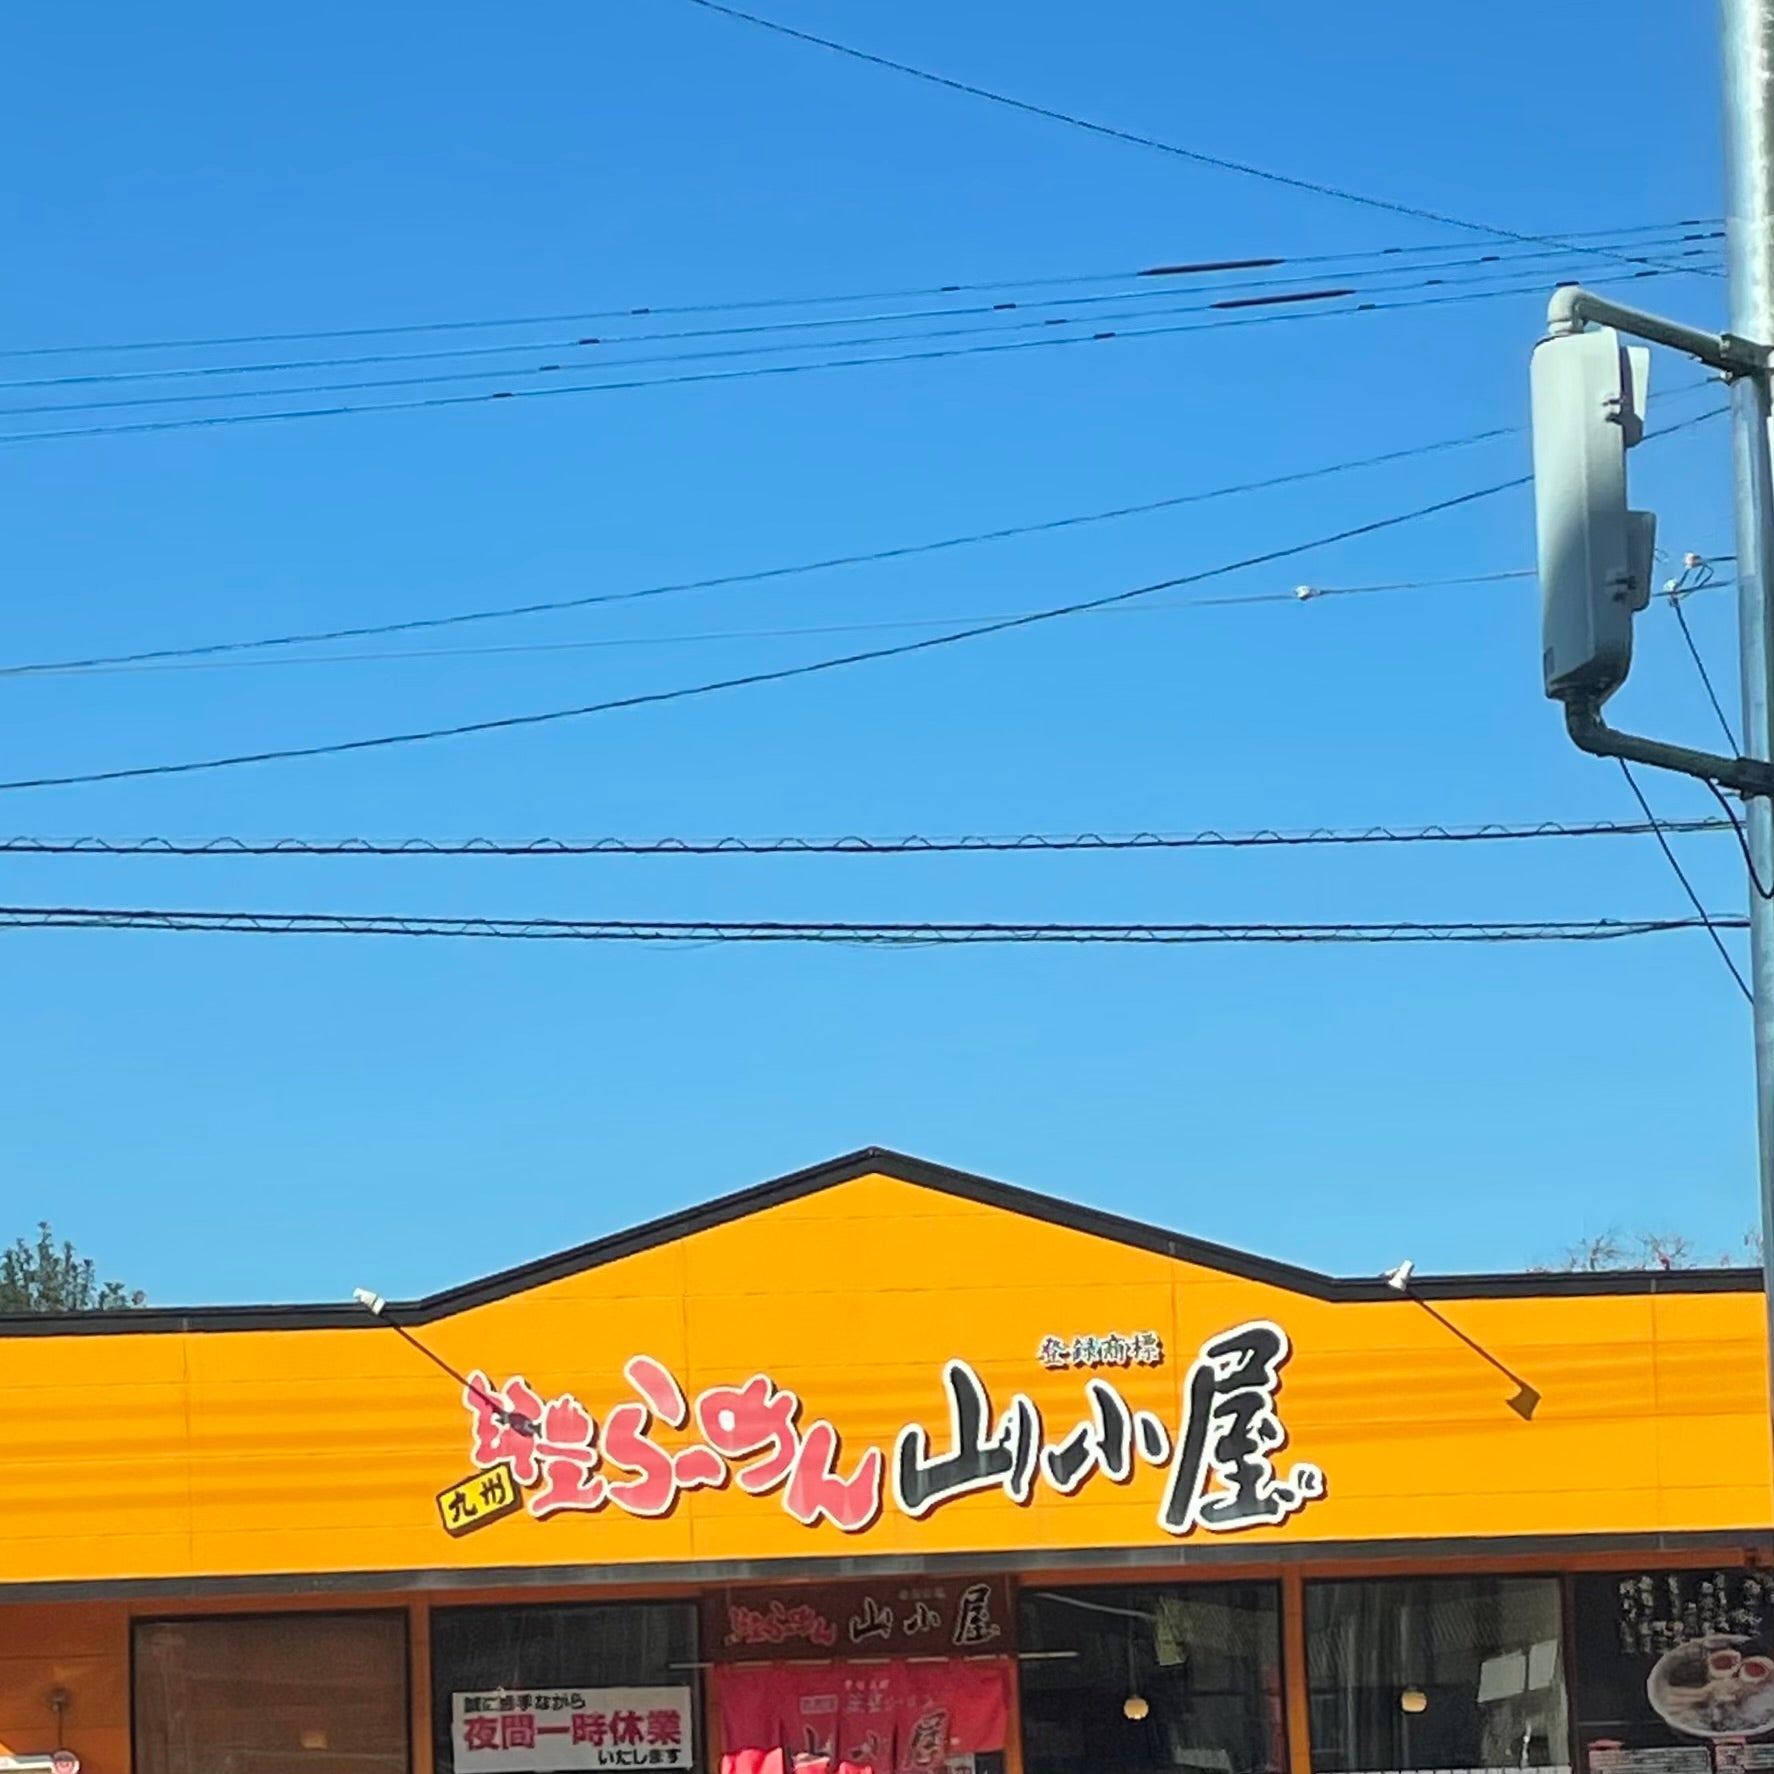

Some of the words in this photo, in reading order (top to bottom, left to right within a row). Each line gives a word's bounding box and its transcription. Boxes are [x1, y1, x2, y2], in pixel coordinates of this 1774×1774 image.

[1038, 1331, 1163, 1367] 登録商標
[894, 1321, 1325, 1534] 山小屋
[447, 1471, 508, 1522] 九州
[849, 1582, 1001, 1646] 山小屋
[463, 1709, 683, 1751] 夜間一時休業
[597, 1748, 683, 1766] いたします
